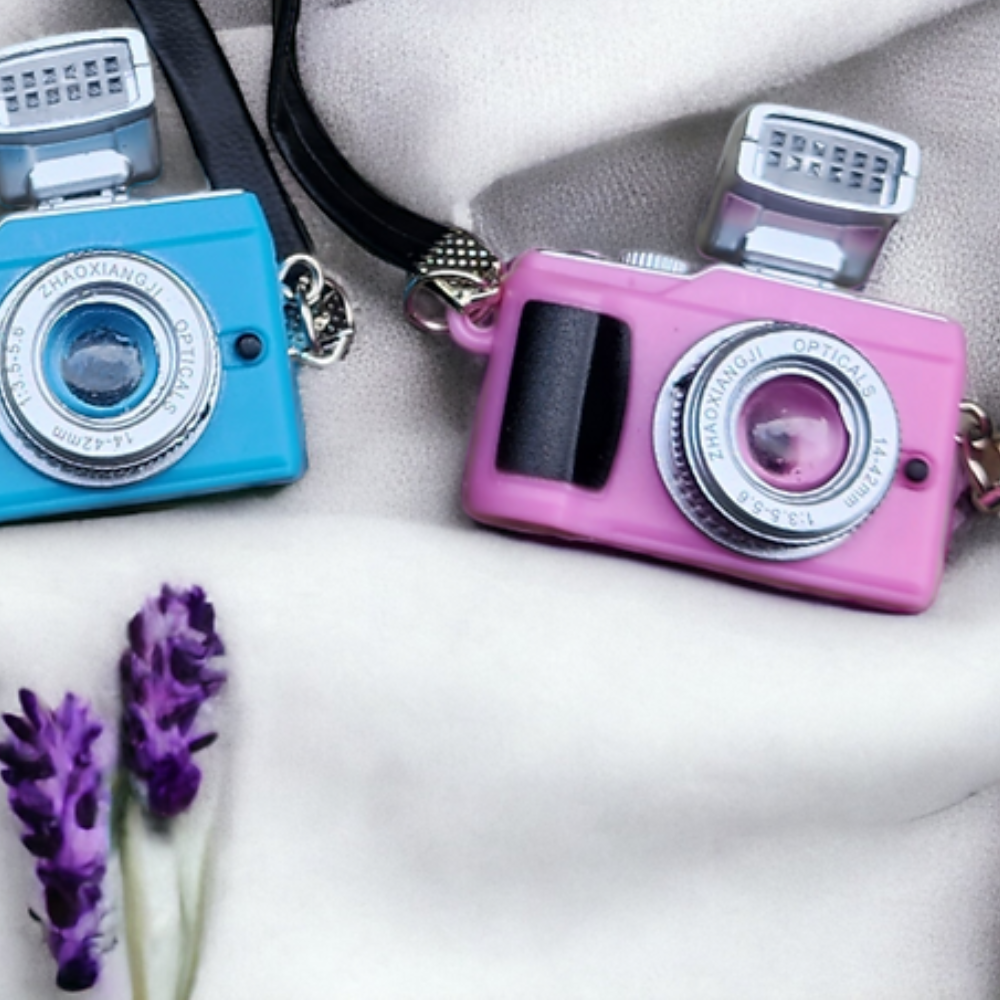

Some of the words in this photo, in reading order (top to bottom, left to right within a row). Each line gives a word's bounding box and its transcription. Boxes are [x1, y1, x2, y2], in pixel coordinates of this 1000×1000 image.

[36, 261, 163, 299] ZHAOXIANGJI
[164, 319, 196, 416] OPTICALS
[703, 346, 763, 461] ZHAOXIANGJI
[793, 338, 877, 398] OPTICALS
[51, 425, 133, 451] 14-42mm
[844, 437, 888, 509] 14-42mm
[736, 490, 815, 526] 1:3.5-5.6
